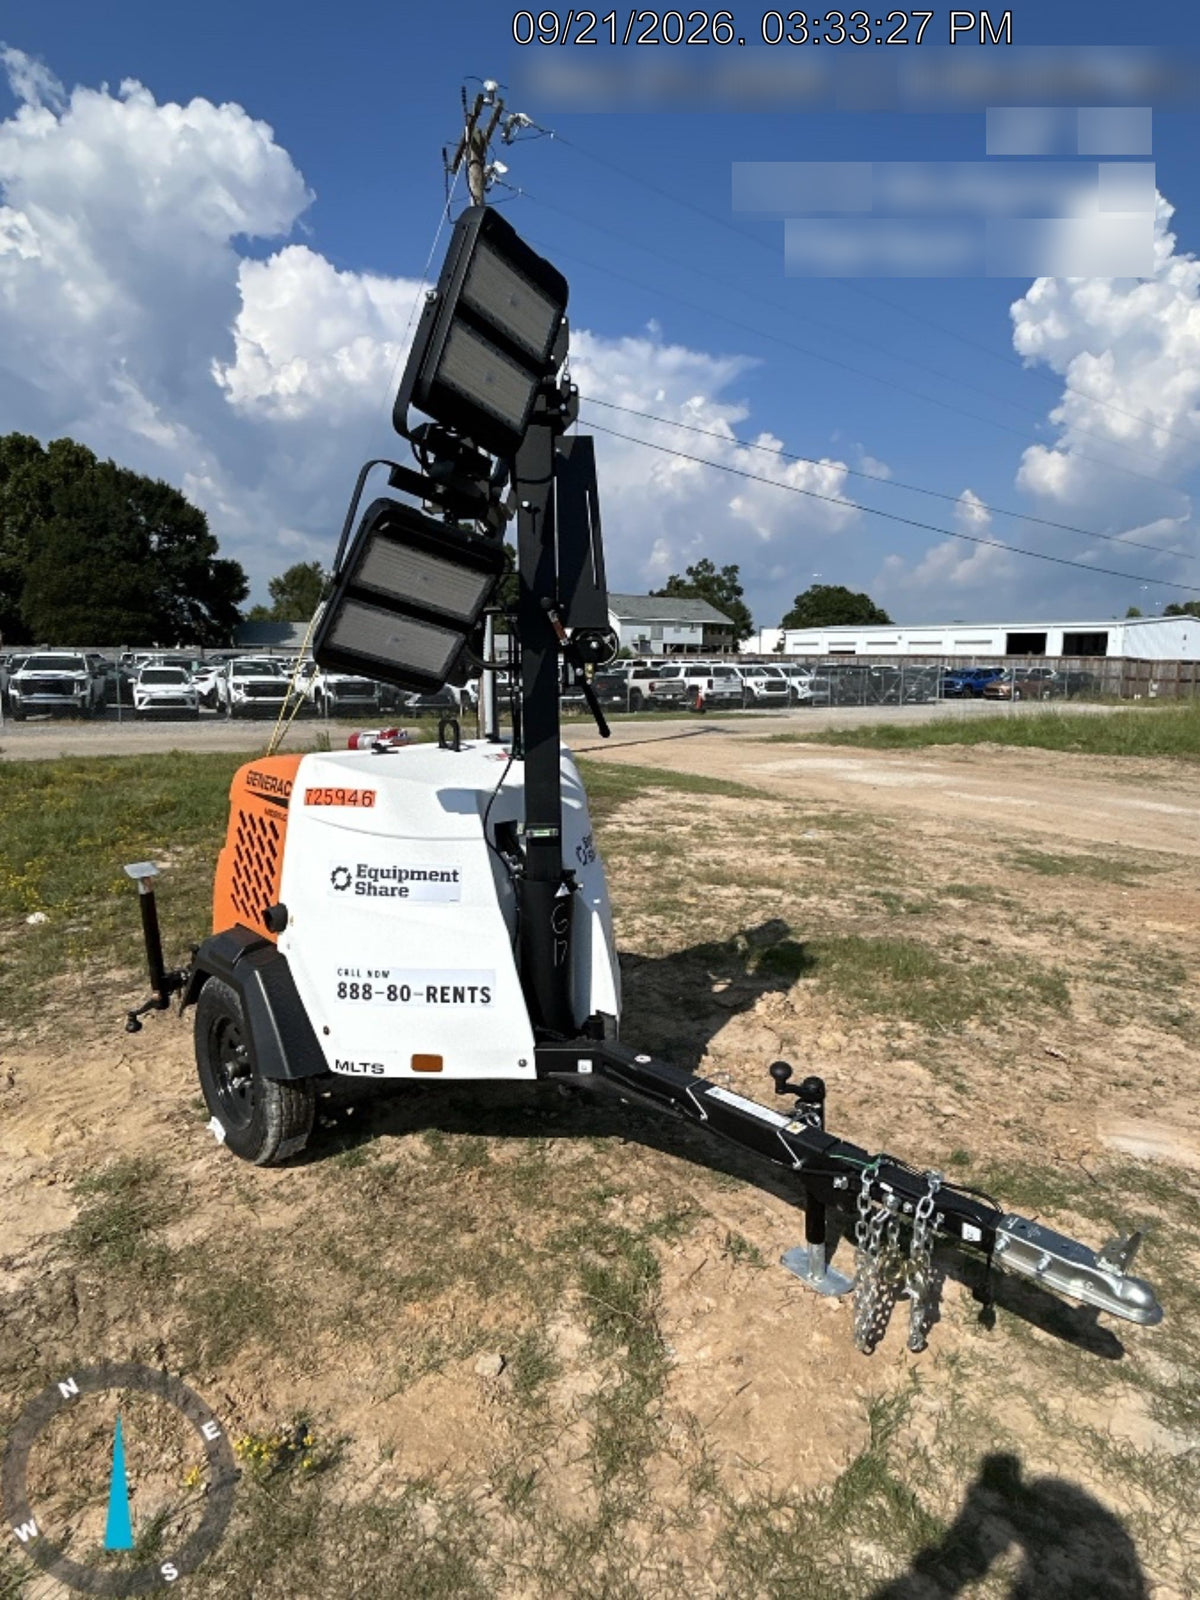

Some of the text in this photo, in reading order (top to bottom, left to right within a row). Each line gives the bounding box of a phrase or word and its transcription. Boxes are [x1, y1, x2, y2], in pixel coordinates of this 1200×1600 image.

[246, 770, 293, 797] GENERAC
[305, 788, 374, 808] 725946
[355, 863, 460, 884] Equipment
[354, 881, 410, 898] Share
[337, 968, 390, 979] CALL NOW
[336, 981, 492, 1004] 888-80-RENTS
[335, 1058, 385, 1075] MLTS
